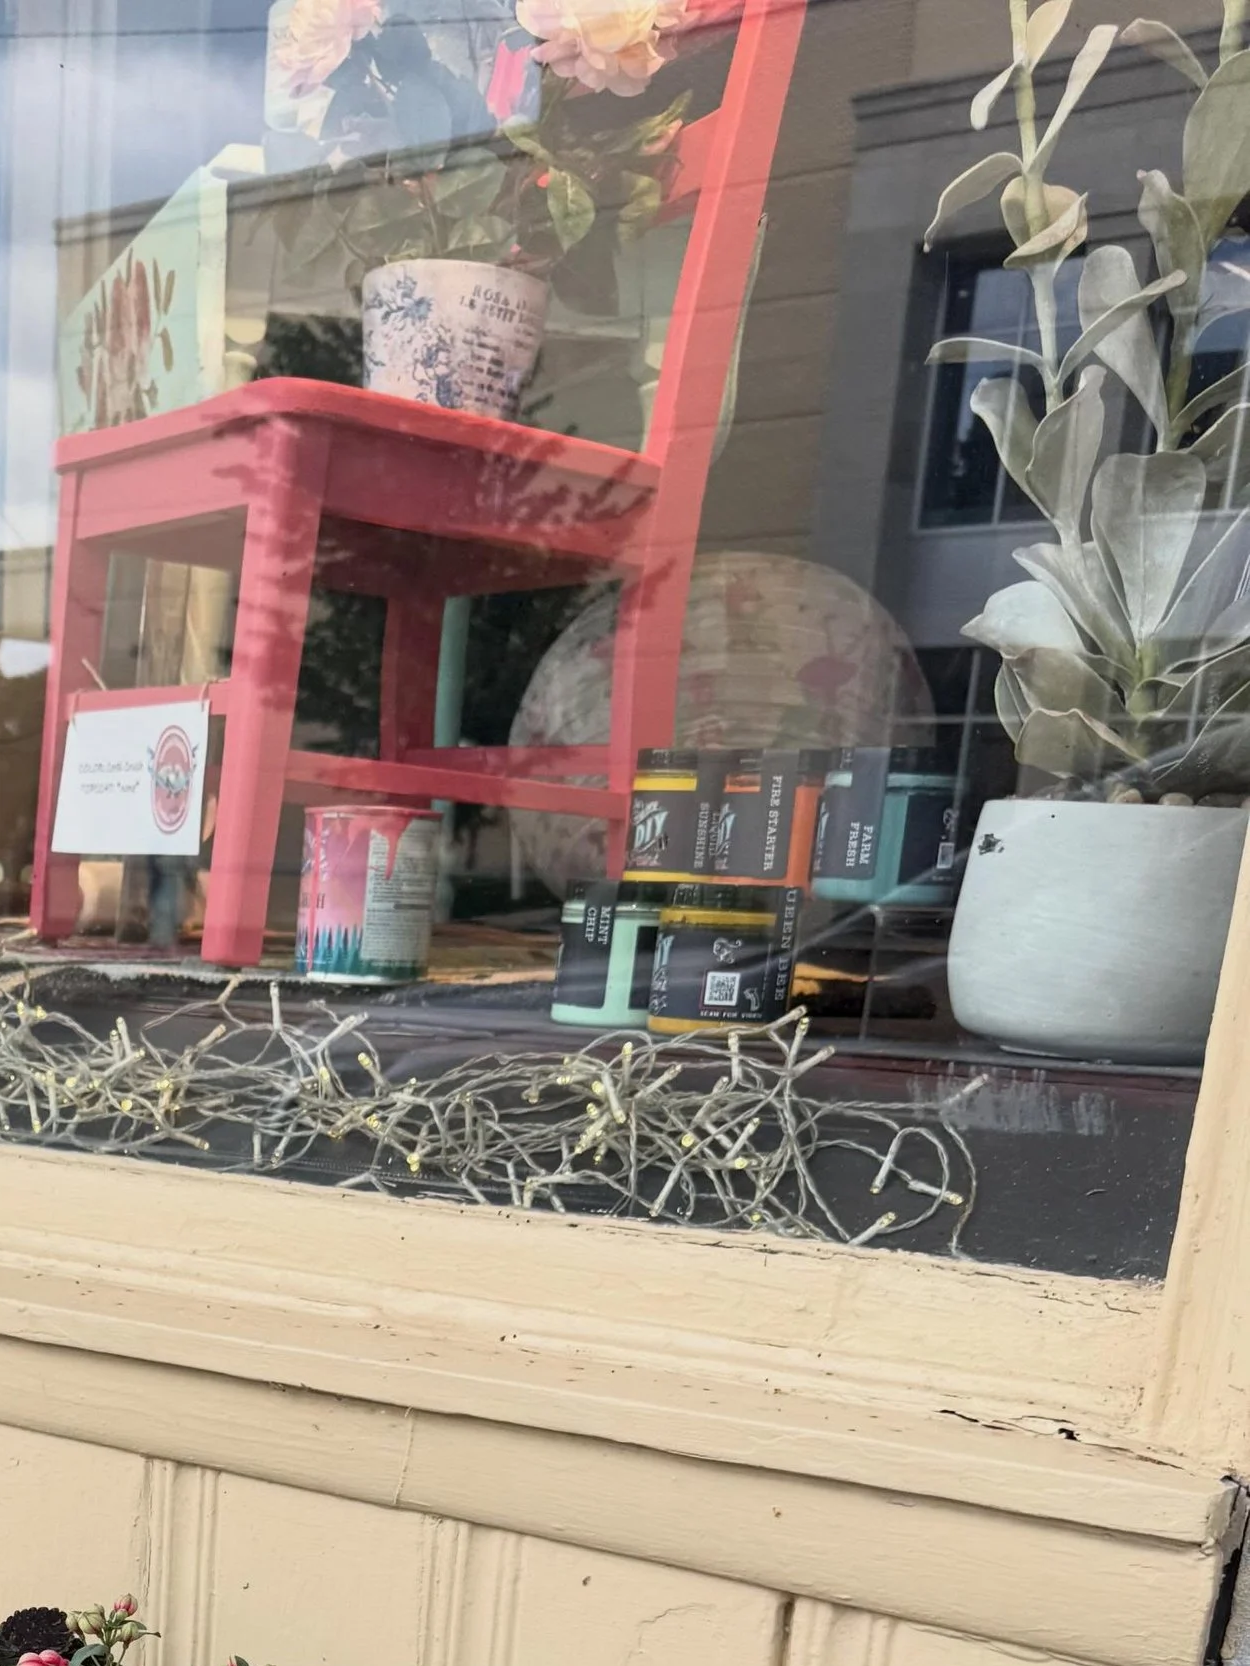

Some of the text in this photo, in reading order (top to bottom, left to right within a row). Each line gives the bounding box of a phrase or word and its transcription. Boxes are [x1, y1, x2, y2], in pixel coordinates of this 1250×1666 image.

[634, 811, 669, 848] DIY
[693, 802, 710, 869] SUNSHINE
[763, 775, 784, 871] FIRE STARTER
[845, 821, 860, 867] FRESH
[859, 825, 874, 865] FARM
[584, 906, 598, 943] CHIP
[597, 905, 612, 945] MINT
[774, 885, 797, 1001] UEEN BEE
